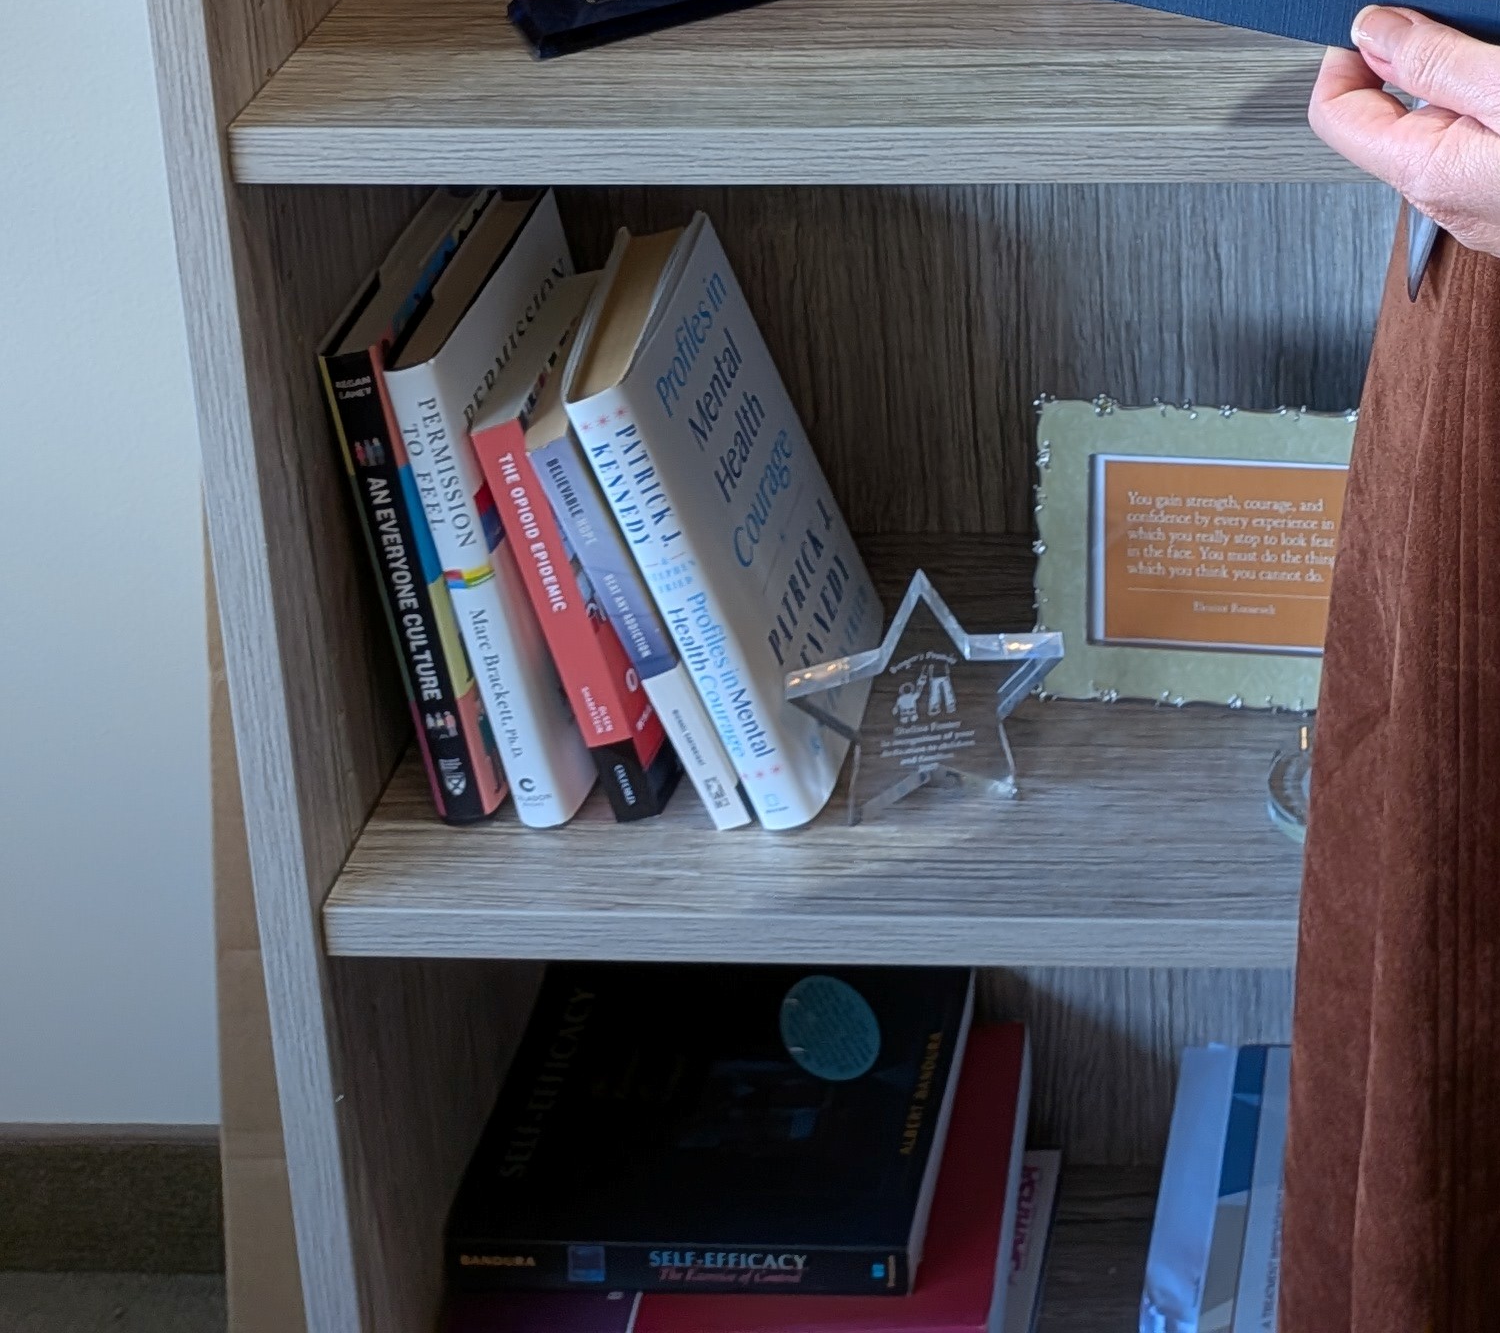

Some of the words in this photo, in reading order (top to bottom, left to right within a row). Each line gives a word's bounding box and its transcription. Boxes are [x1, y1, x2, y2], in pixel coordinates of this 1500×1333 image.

[655, 299, 714, 419] Profiles
[703, 271, 728, 313] in
[687, 327, 744, 451] Mental
[366, 476, 393, 506] AN
[403, 423, 425, 457] TO
[416, 471, 446, 531] FEEL
[417, 396, 478, 548] PERMISSION
[498, 452, 522, 485] THE
[546, 457, 585, 519] BELIEVABLE
[591, 443, 654, 545] KENNEDY
[614, 423, 676, 526] PATRICK
[713, 390, 767, 504] Health
[509, 486, 541, 540] OPIOID
[732, 429, 794, 569] Courage
[375, 507, 420, 610] EVERYONE
[530, 541, 568, 614] EPIDEMIC
[402, 612, 444, 702] CULTURE
[469, 608, 493, 653] Marc
[482, 652, 512, 727] Brackett,
[686, 591, 730, 670] Profiles
[719, 667, 741, 690] in
[667, 607, 710, 672] Health
[699, 674, 746, 759] Courage
[728, 687, 776, 758] Mental
[648, 1249, 807, 1271] SELF-EFFICACY
